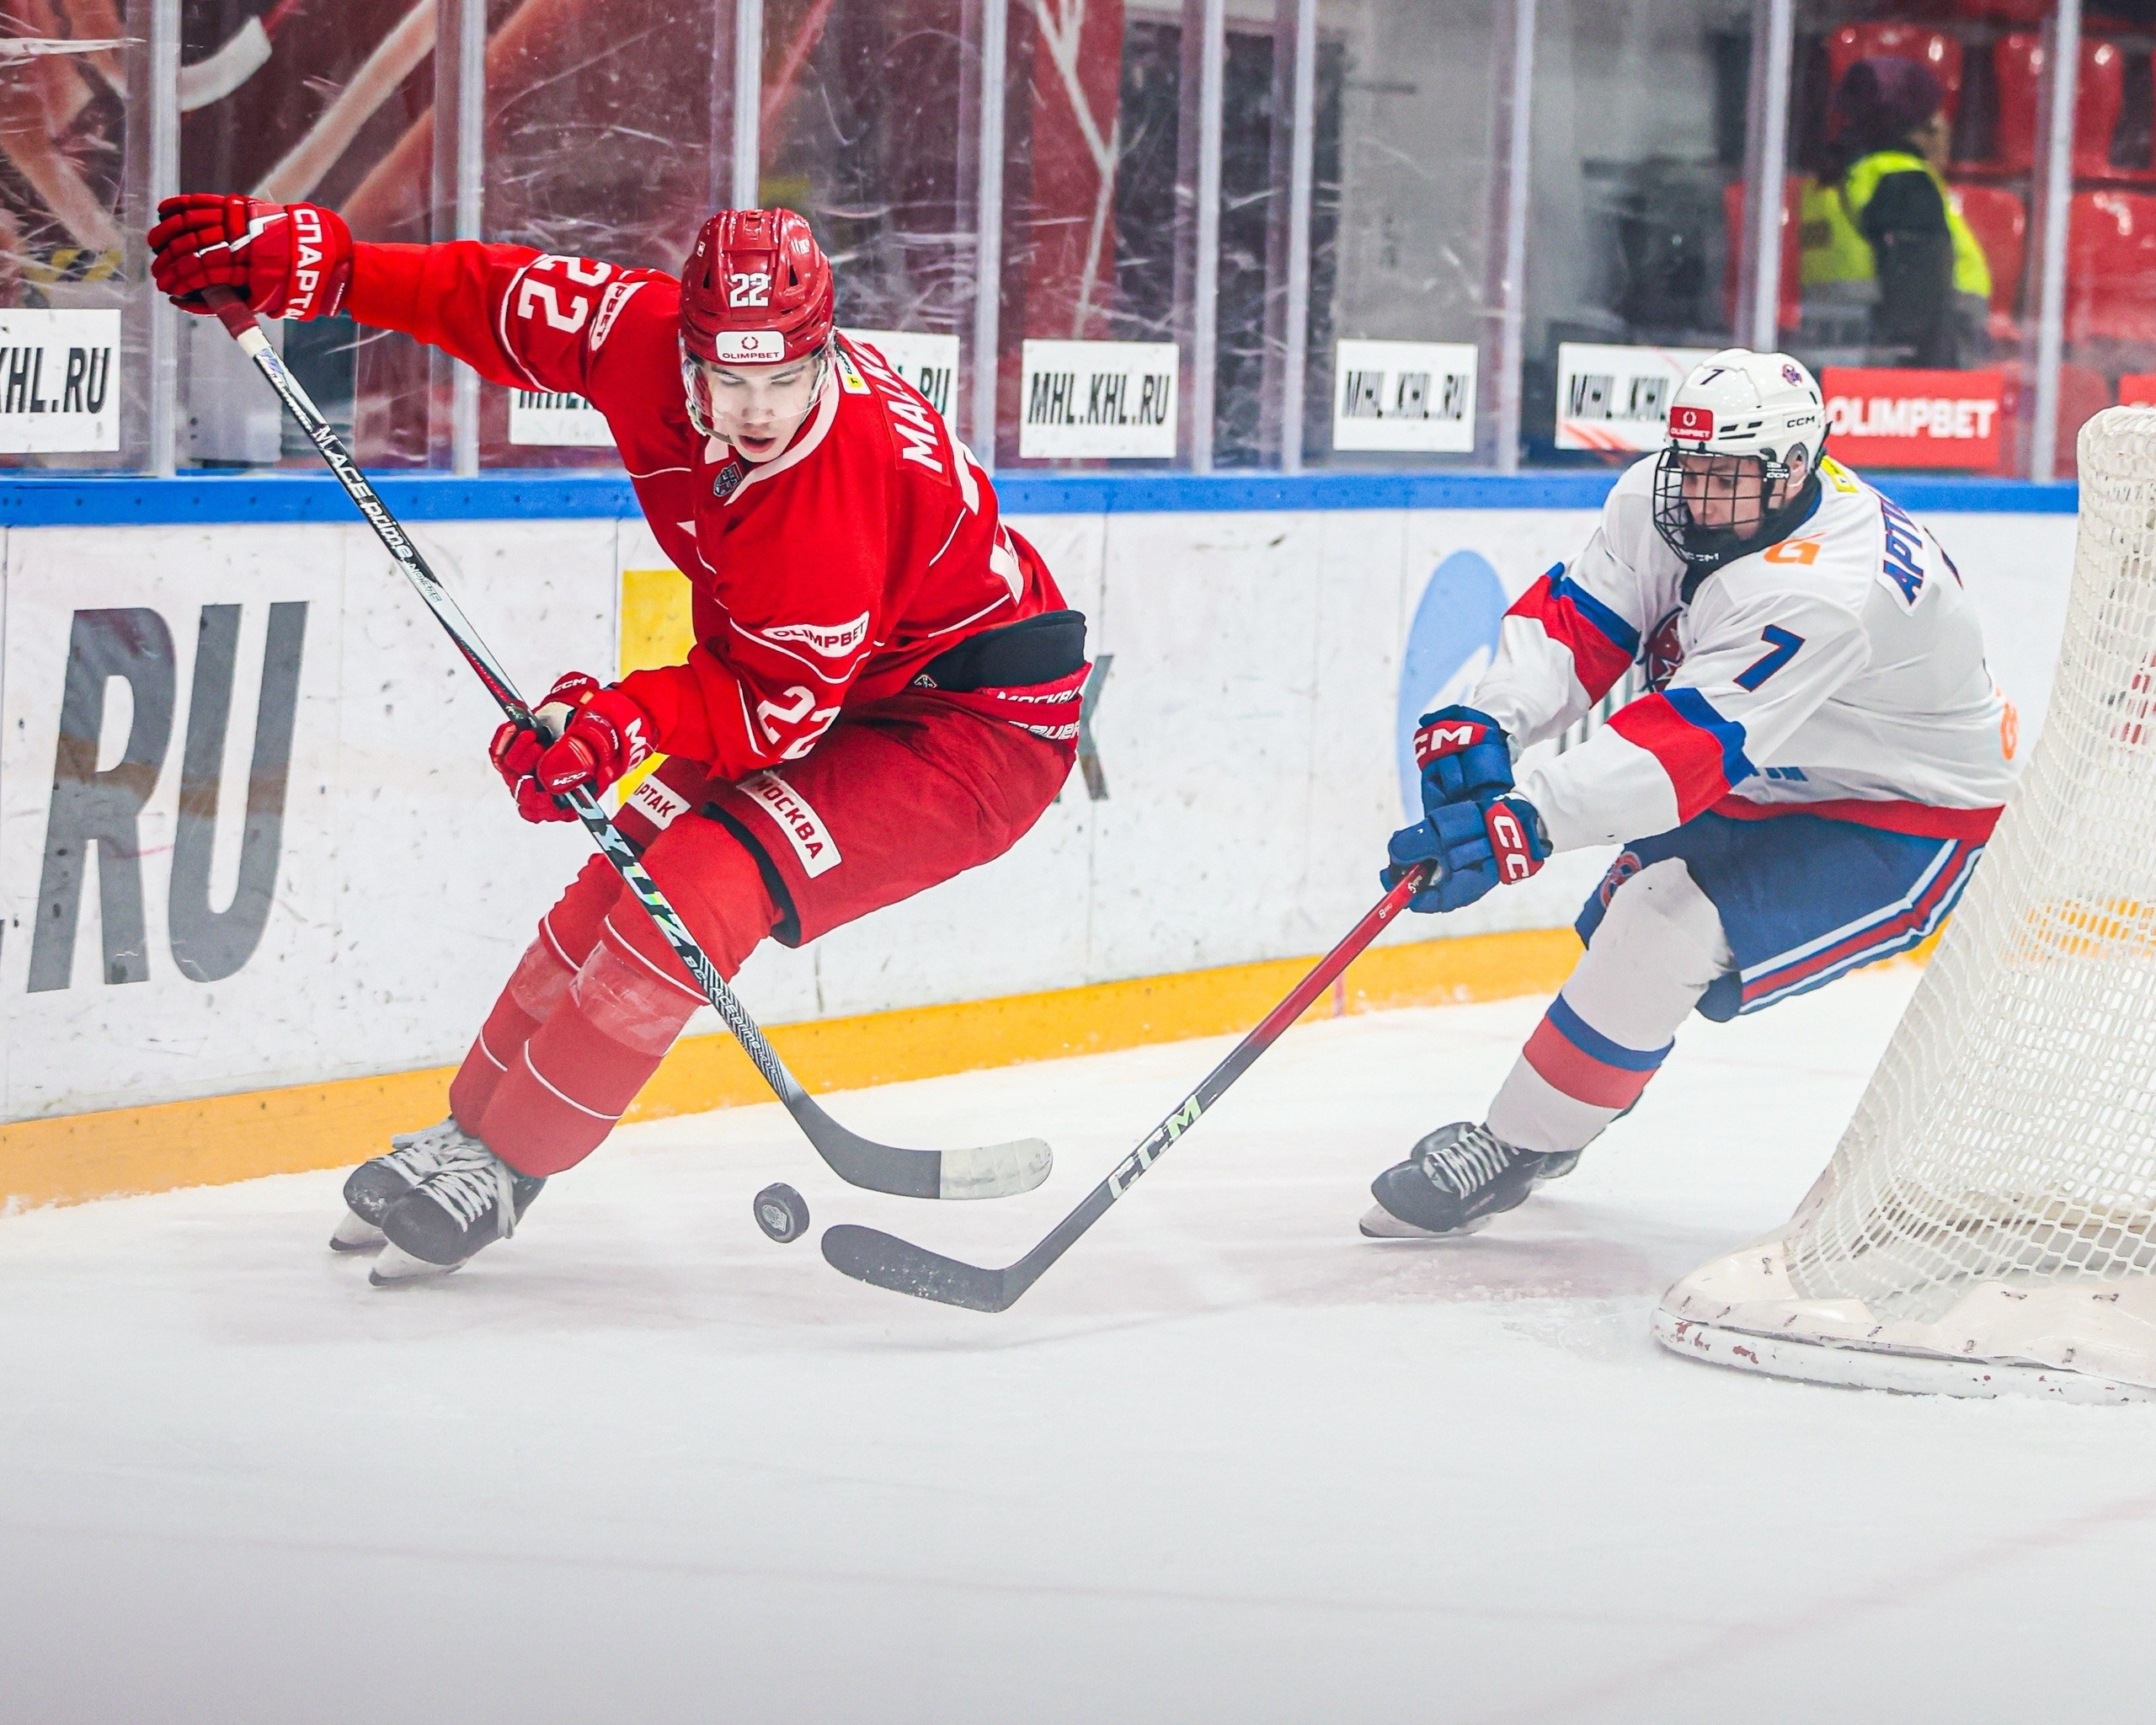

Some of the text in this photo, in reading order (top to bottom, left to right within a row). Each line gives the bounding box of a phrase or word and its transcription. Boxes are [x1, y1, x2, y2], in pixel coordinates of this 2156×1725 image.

[517, 255, 612, 334] 22
[729, 272, 770, 307] 22
[722, 351, 779, 360] OLIMPBET
[1700, 368, 1726, 386] 7
[1027, 371, 1171, 425] MHL.KHL.RU
[1787, 415, 1816, 428] CCM
[1826, 398, 1997, 439] OLIMPBET
[773, 620, 868, 649] OLIMPBET
[1732, 624, 1806, 692] 7
[552, 676, 588, 693] CCM
[552, 771, 588, 787] CCM
[0, 601, 310, 994] RU
[1107, 1094, 1203, 1199] CCM
